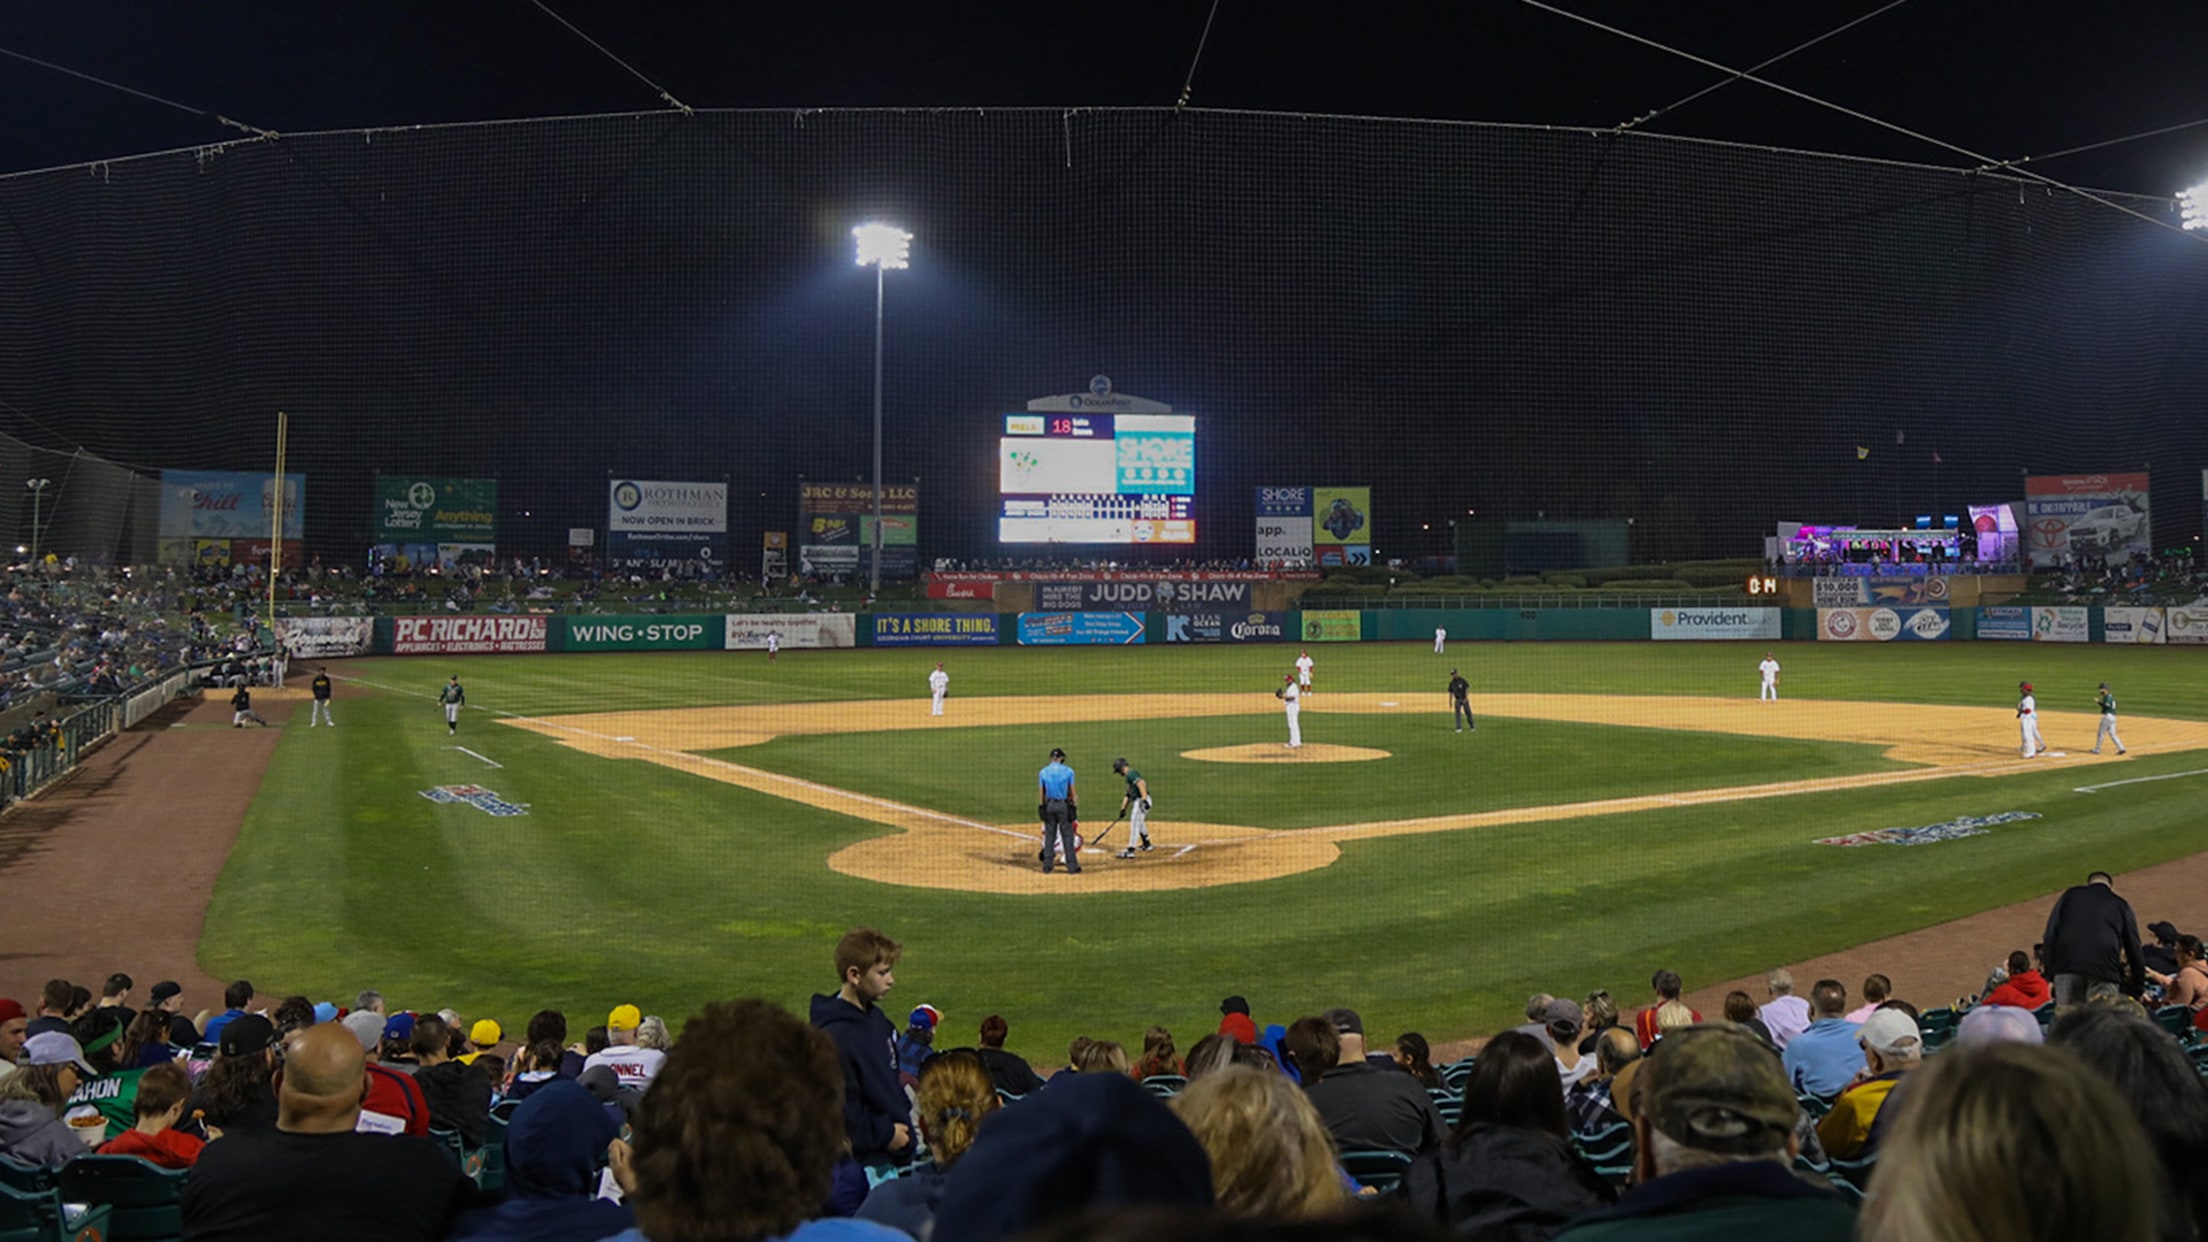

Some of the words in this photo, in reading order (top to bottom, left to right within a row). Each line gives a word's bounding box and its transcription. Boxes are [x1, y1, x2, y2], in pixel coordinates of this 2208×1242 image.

[1053, 419, 1071, 433] 18
[644, 488, 725, 501] ROTHMAN
[803, 487, 832, 498] JRC
[889, 489, 916, 500] LLC
[1262, 488, 1305, 501] SHORE
[385, 499, 409, 509] New
[390, 510, 423, 520] Jersey
[435, 511, 493, 524] Anything
[622, 516, 646, 526] NOW
[647, 516, 674, 526] OPEN
[675, 517, 686, 526] IN
[687, 517, 716, 526] BRICK
[385, 517, 422, 530] Lottery
[1089, 584, 1152, 601] JUDD
[1177, 584, 1245, 601] SHAW
[1678, 611, 1748, 625] Provident
[430, 618, 531, 641] RICHARD
[877, 617, 900, 633] IT'S
[903, 618, 912, 633] A
[914, 618, 952, 633] SHORE
[955, 618, 996, 633] THING.
[1231, 621, 1281, 640] Corona
[572, 624, 634, 642] WING
[646, 624, 704, 641] STOP
